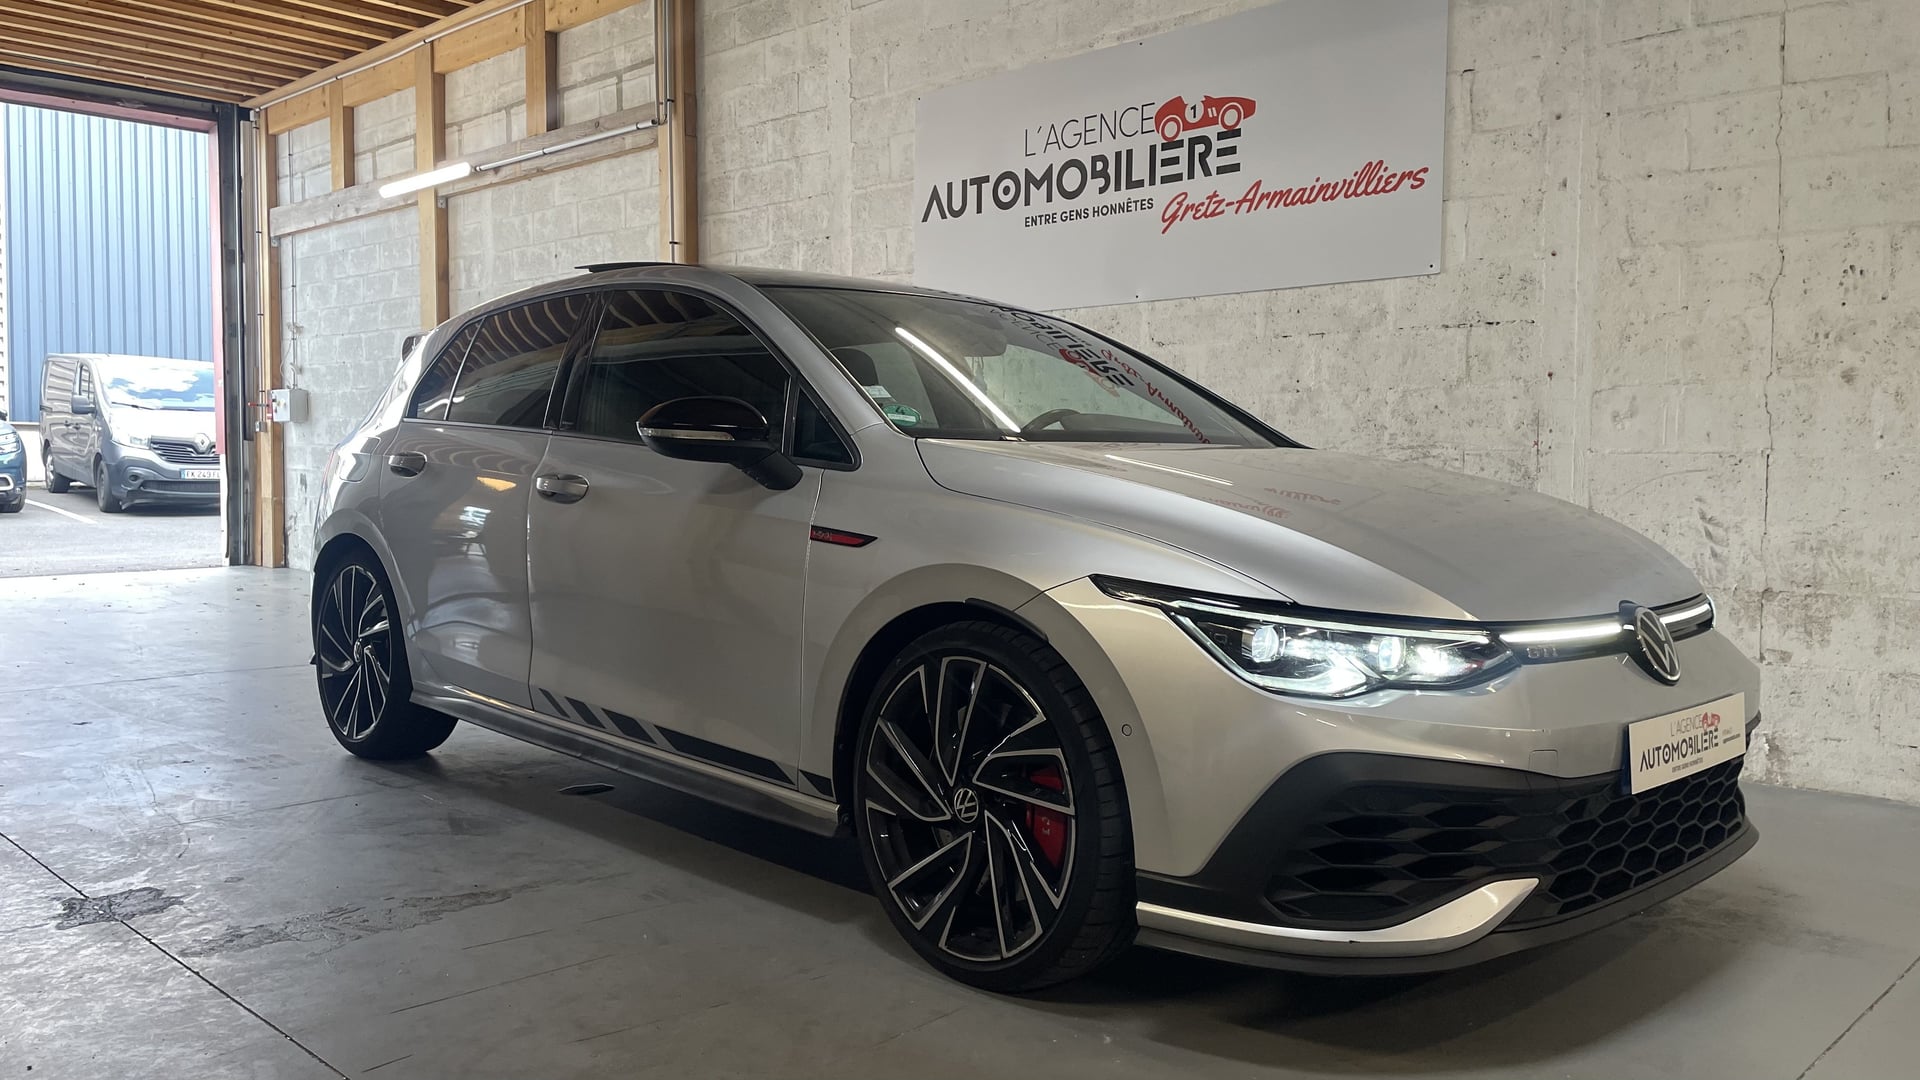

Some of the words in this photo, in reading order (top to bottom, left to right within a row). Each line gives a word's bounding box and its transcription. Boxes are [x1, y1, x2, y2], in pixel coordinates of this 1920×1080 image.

[1024, 102, 1156, 157] L'AGENCE
[1190, 104, 1198, 119] 1
[1024, 212, 1058, 228] ENTRE
[1060, 207, 1090, 222] GENS
[1092, 197, 1154, 218] HONNÊTES
[1161, 159, 1429, 235] Gretz-Armainvilliers
